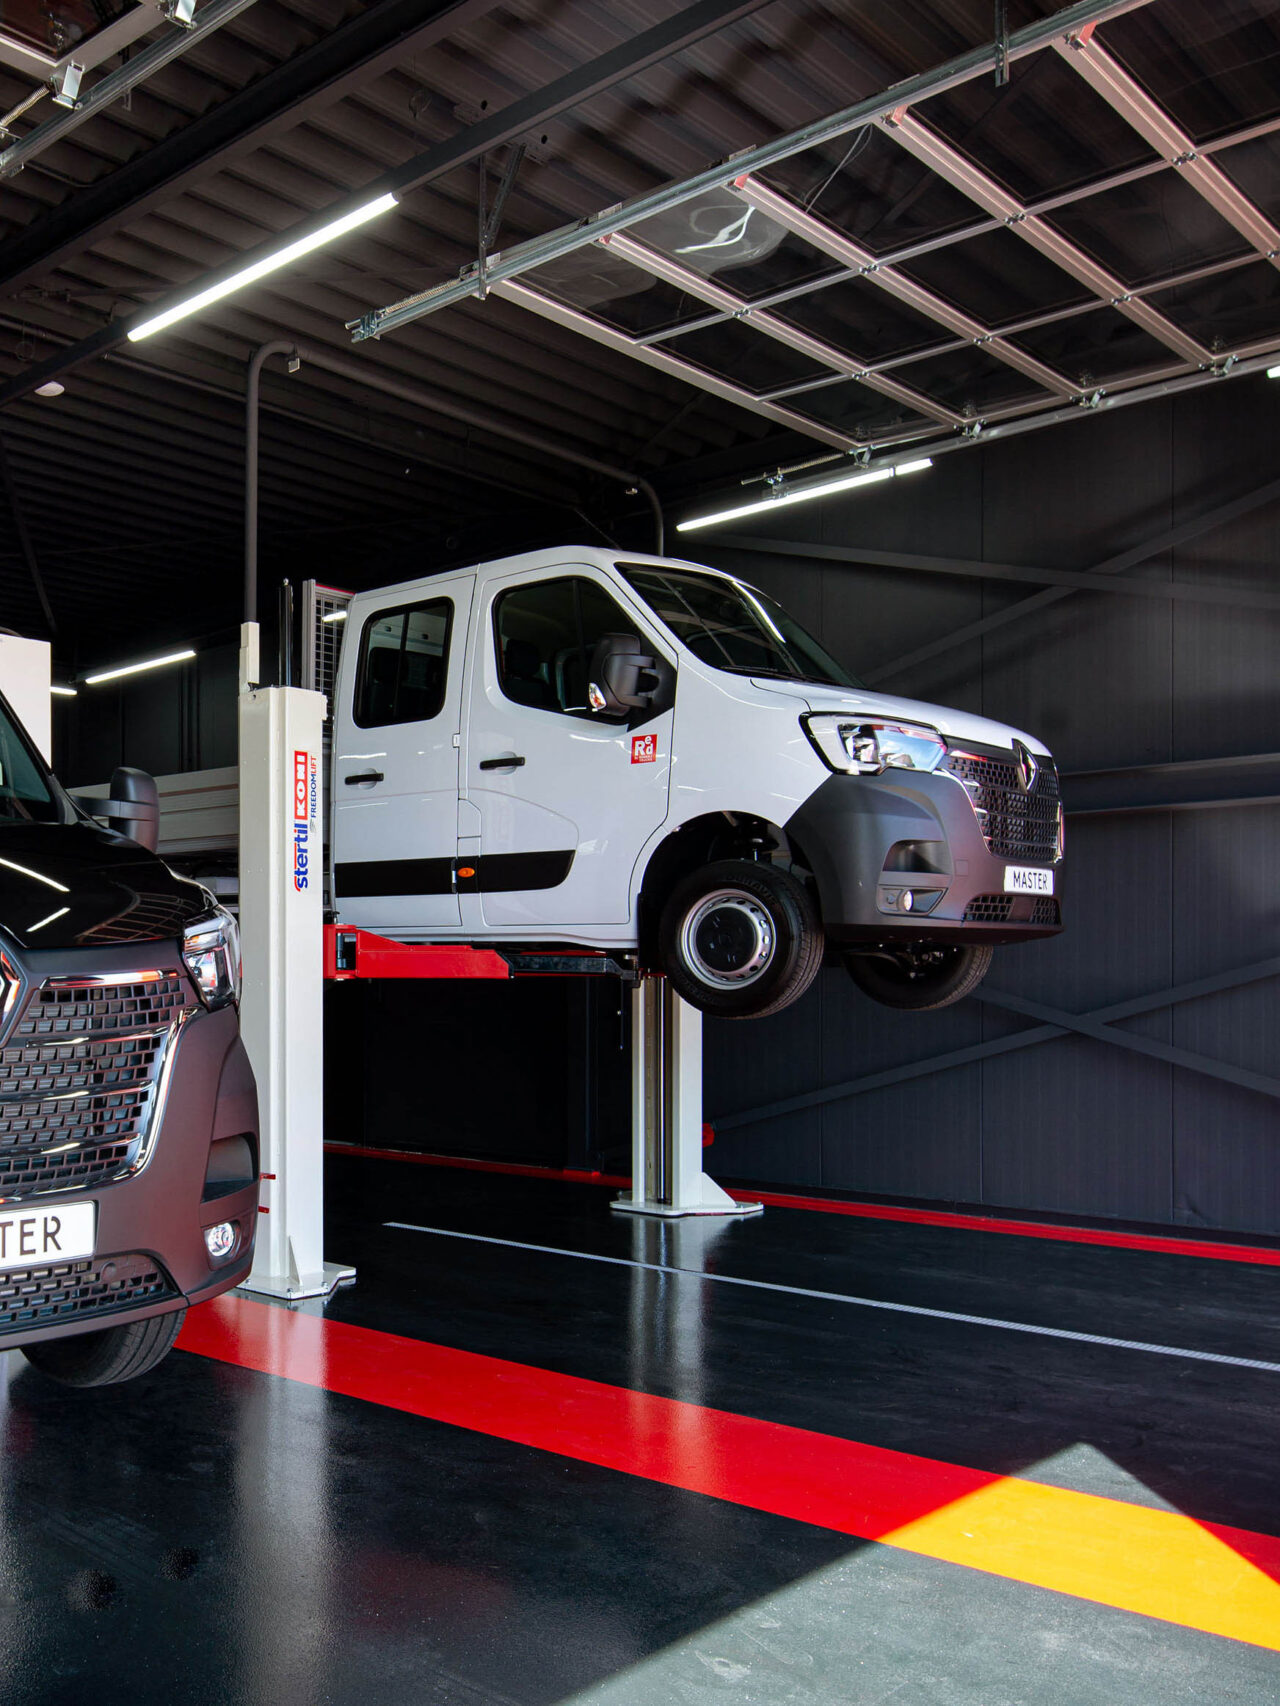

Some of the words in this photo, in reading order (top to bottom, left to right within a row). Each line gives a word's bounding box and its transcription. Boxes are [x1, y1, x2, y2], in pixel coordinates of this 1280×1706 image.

[296, 754, 306, 817] KONI
[293, 822, 308, 892] stertil
[1013, 870, 1048, 891] MASTER
